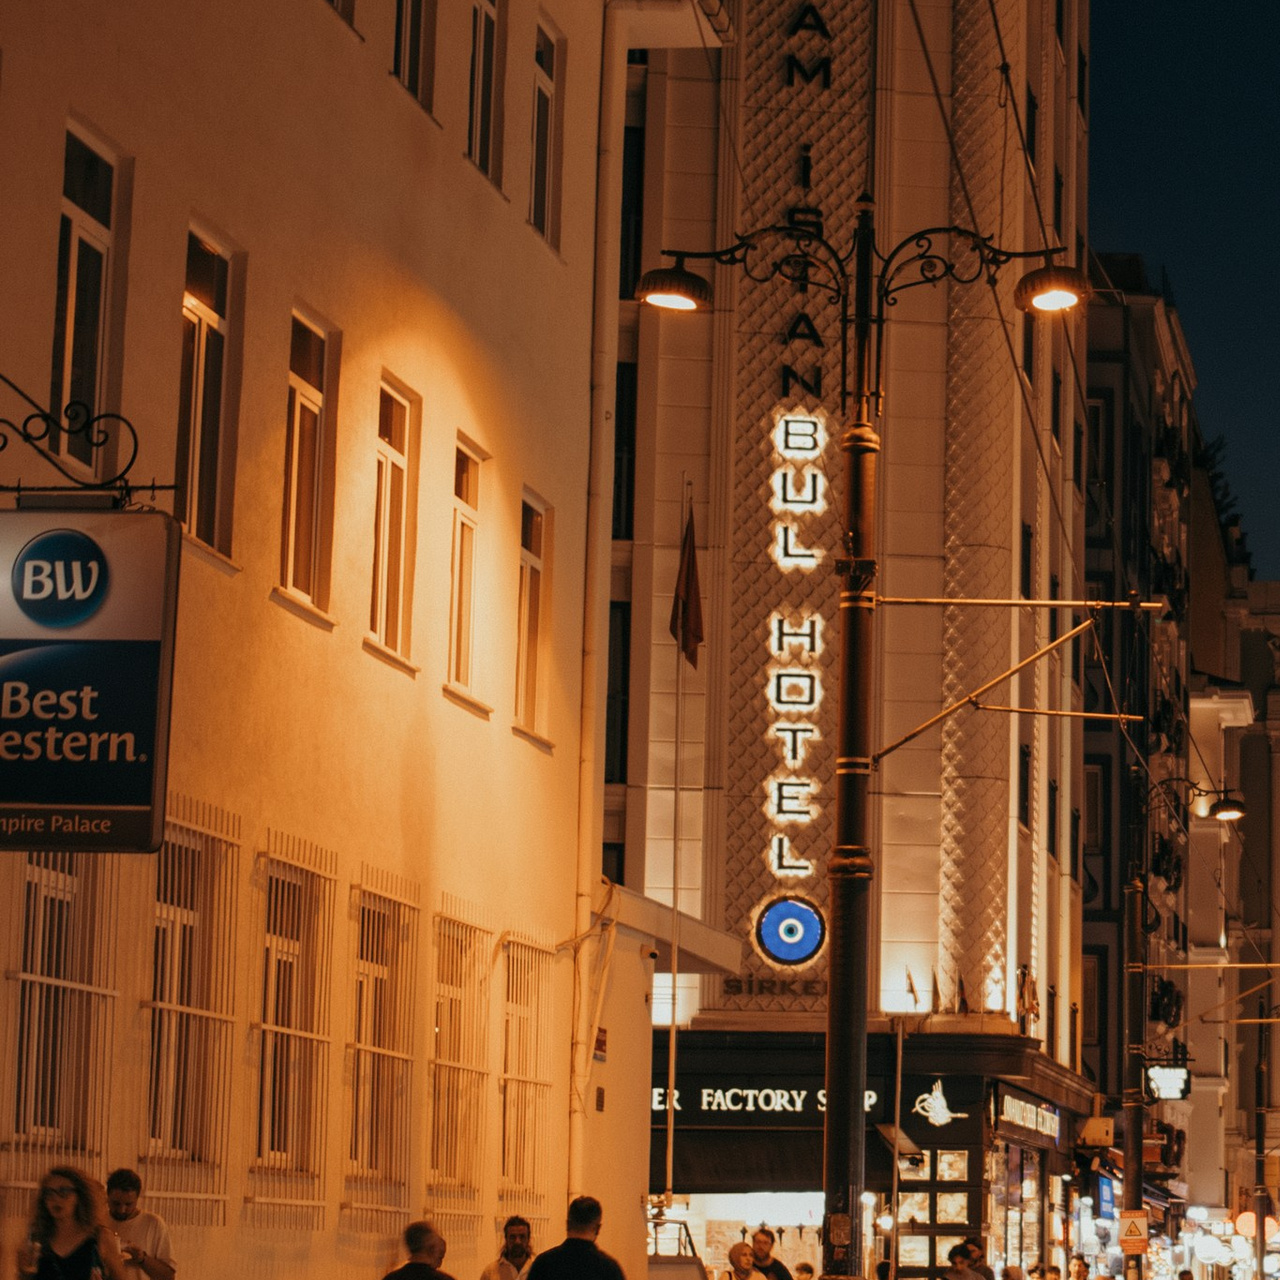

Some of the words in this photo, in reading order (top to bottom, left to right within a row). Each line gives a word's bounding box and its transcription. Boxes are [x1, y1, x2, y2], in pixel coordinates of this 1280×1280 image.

[23, 560, 98, 600] BW
[2, 681, 99, 720] Best
[0, 726, 136, 762] estern
[776, 619, 816, 871] HOTEL
[0, 814, 45, 835] pire
[51, 815, 112, 833] Palace
[724, 972, 827, 995] SİRKE
[701, 1088, 807, 1111] FACTORY
[817, 1089, 877, 1112] SP
